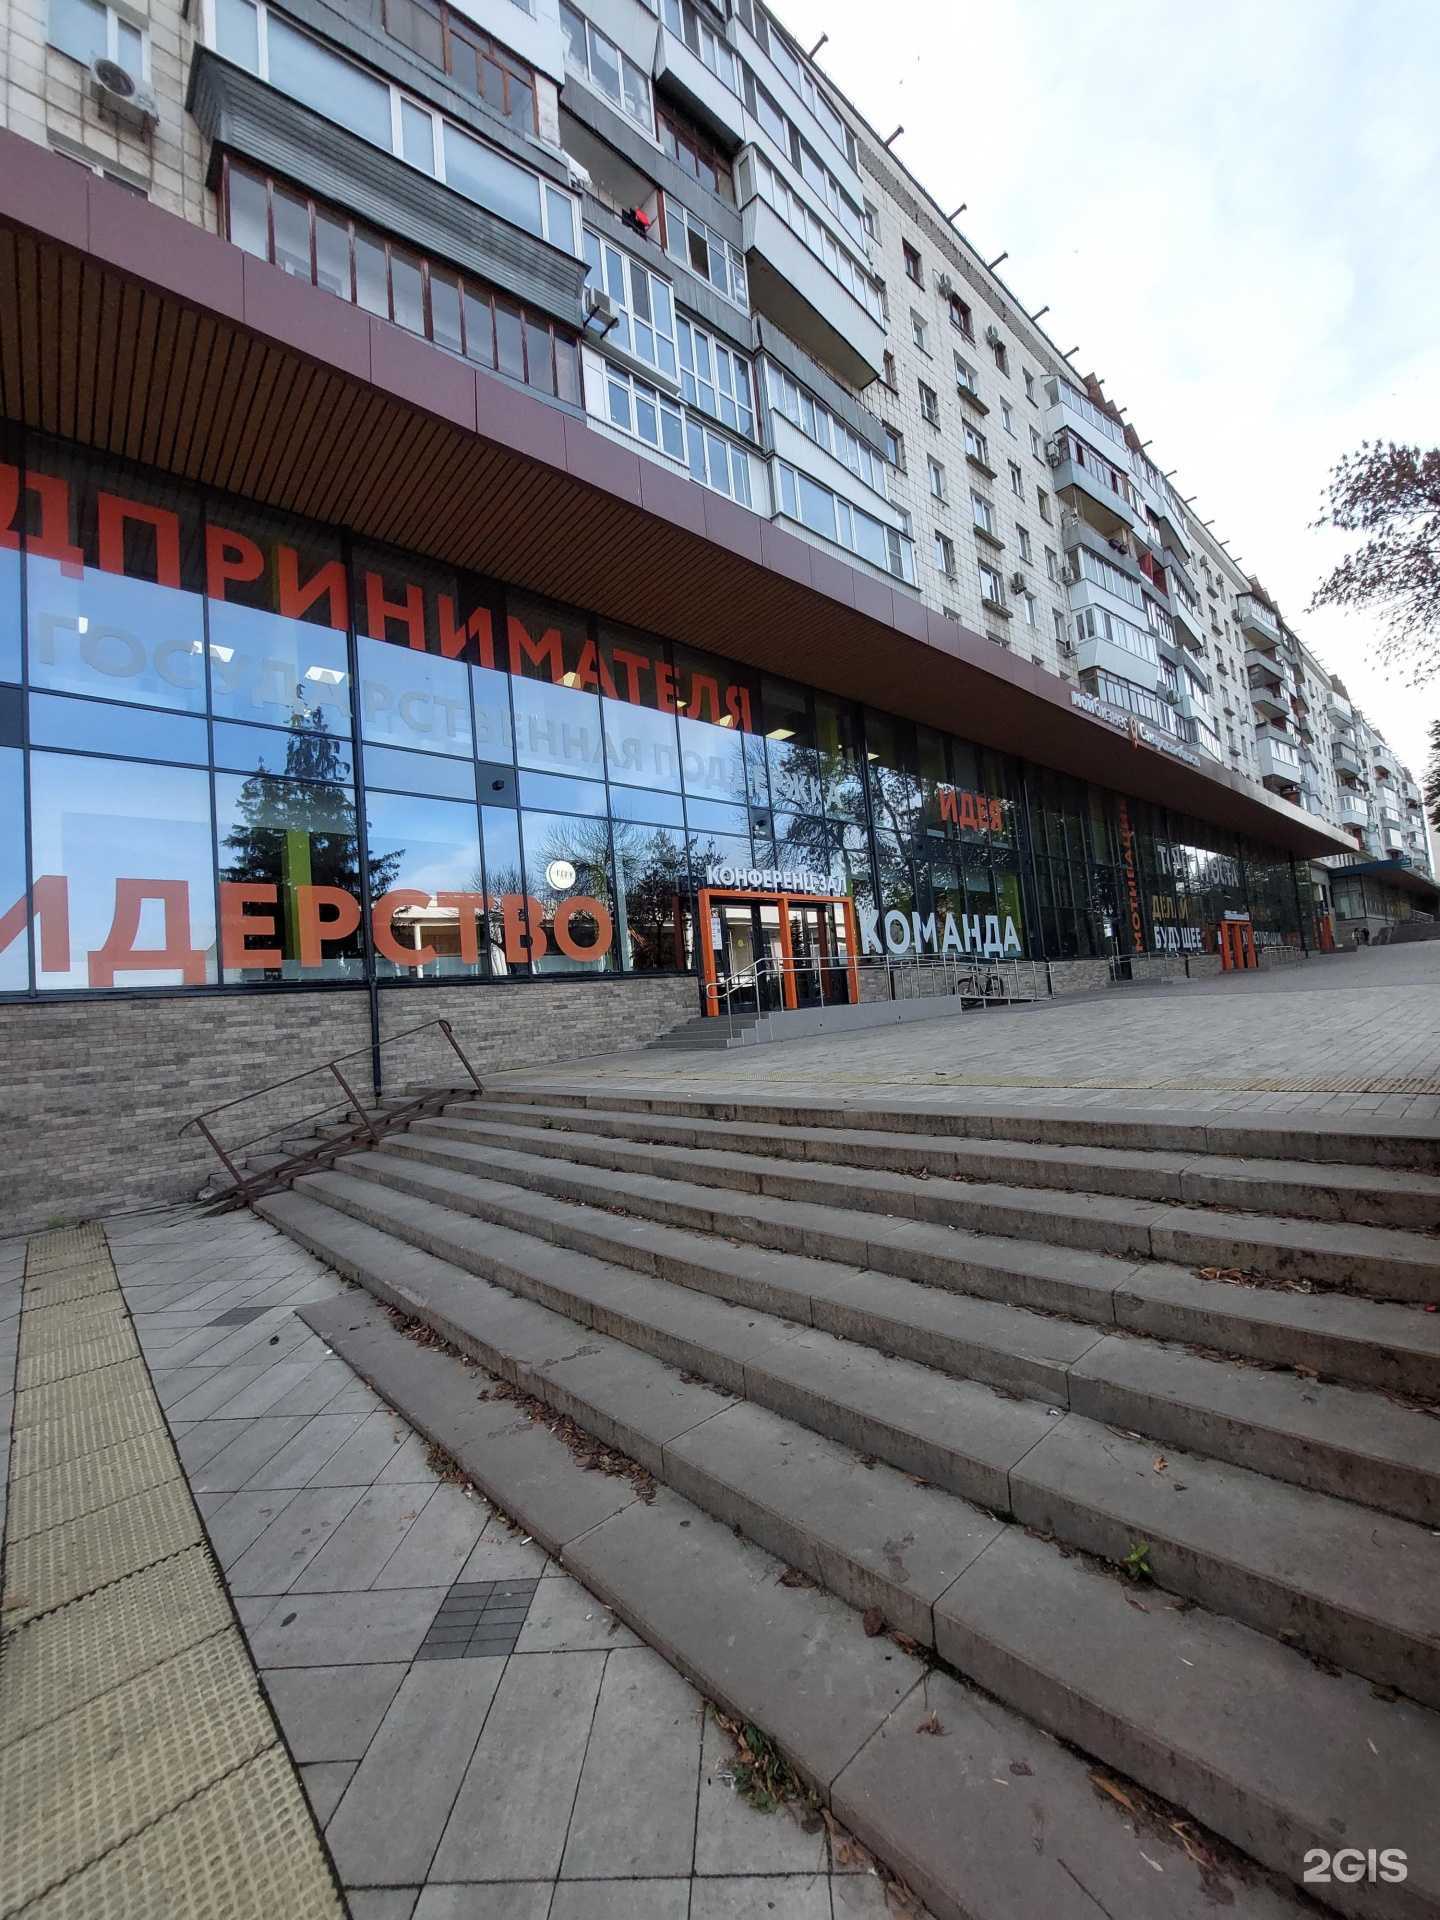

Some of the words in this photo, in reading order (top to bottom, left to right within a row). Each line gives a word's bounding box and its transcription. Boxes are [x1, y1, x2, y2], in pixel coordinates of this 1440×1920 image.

[938, 789, 1002, 832] ИДЕЯ
[706, 864, 848, 897] КОНФЕРЕНЦ-ЗАЛ
[858, 909, 1022, 958] КОМАНДА
[1154, 926, 1202, 951] БУДУЩЕЕ
